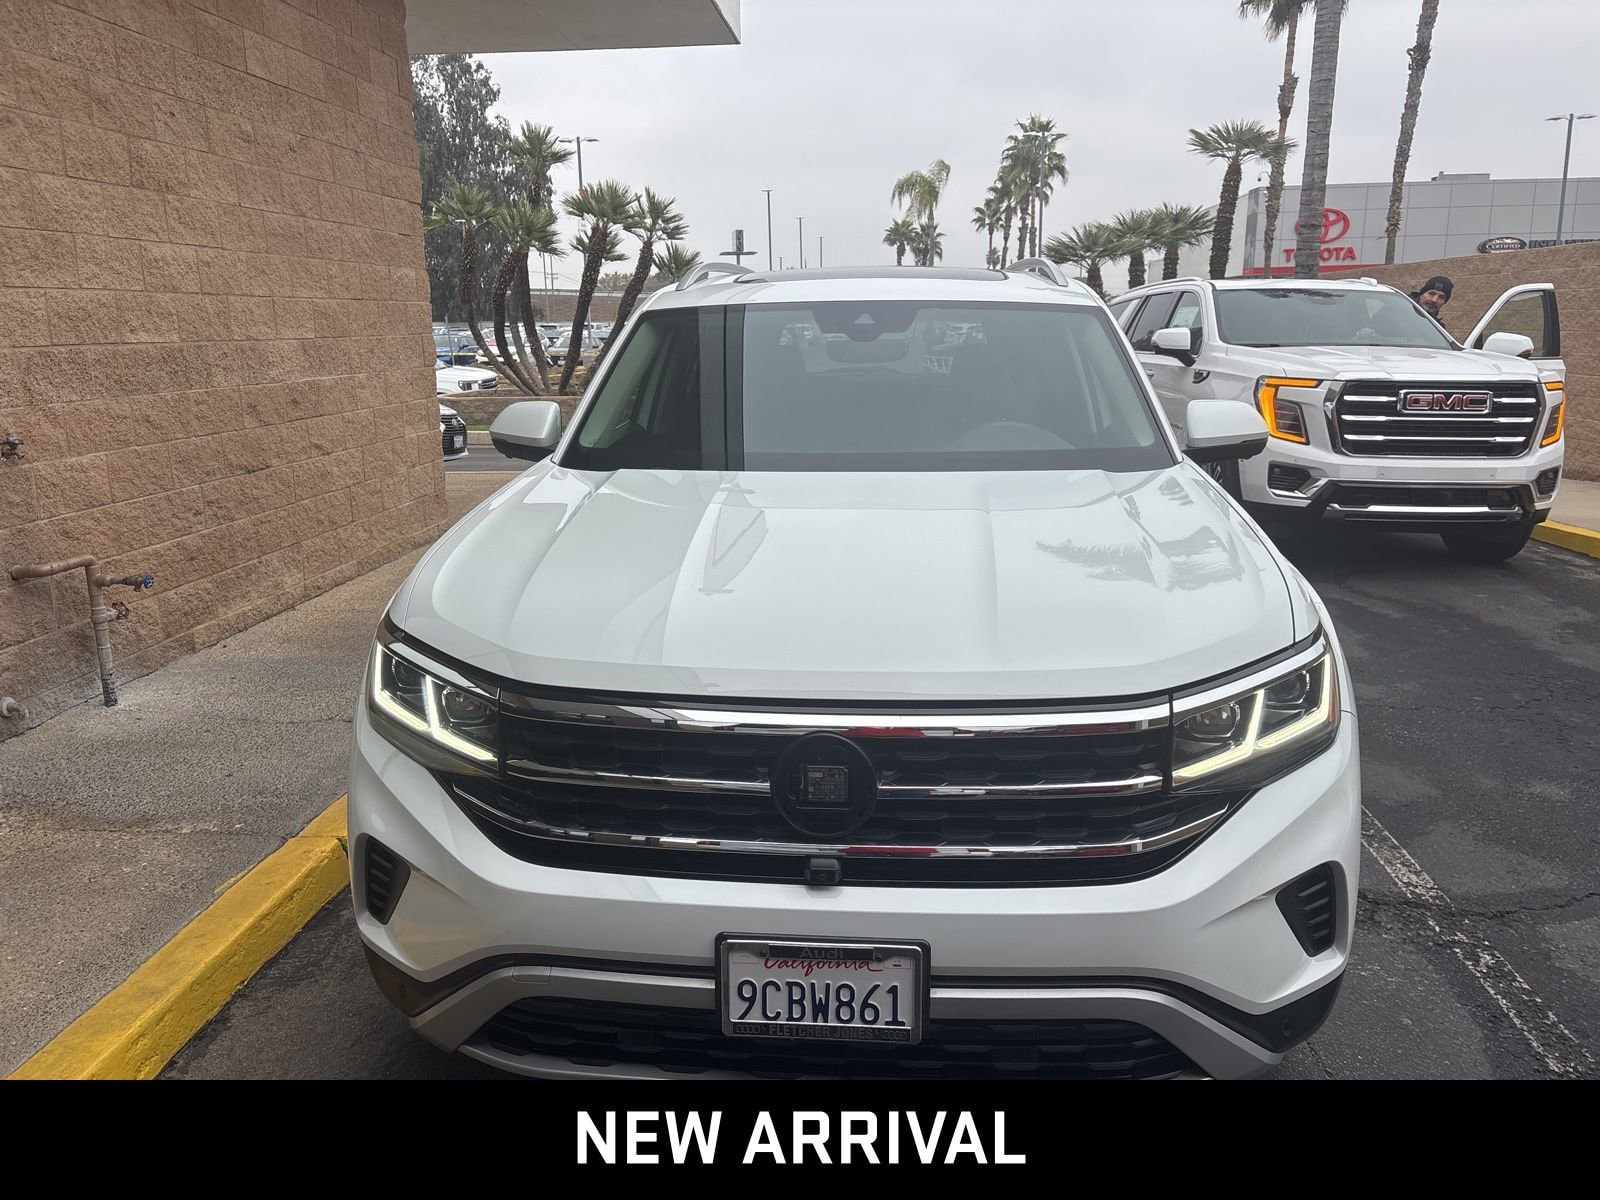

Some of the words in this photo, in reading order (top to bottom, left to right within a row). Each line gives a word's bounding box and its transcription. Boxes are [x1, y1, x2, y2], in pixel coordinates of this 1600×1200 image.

[1283, 246, 1356, 262] TOTA
[1406, 393, 1488, 410] GMC
[800, 948, 844, 960] Audi
[737, 979, 905, 1026] 9CBW861
[769, 1023, 831, 1038] FLETCHER
[834, 1027, 873, 1040] JONES
